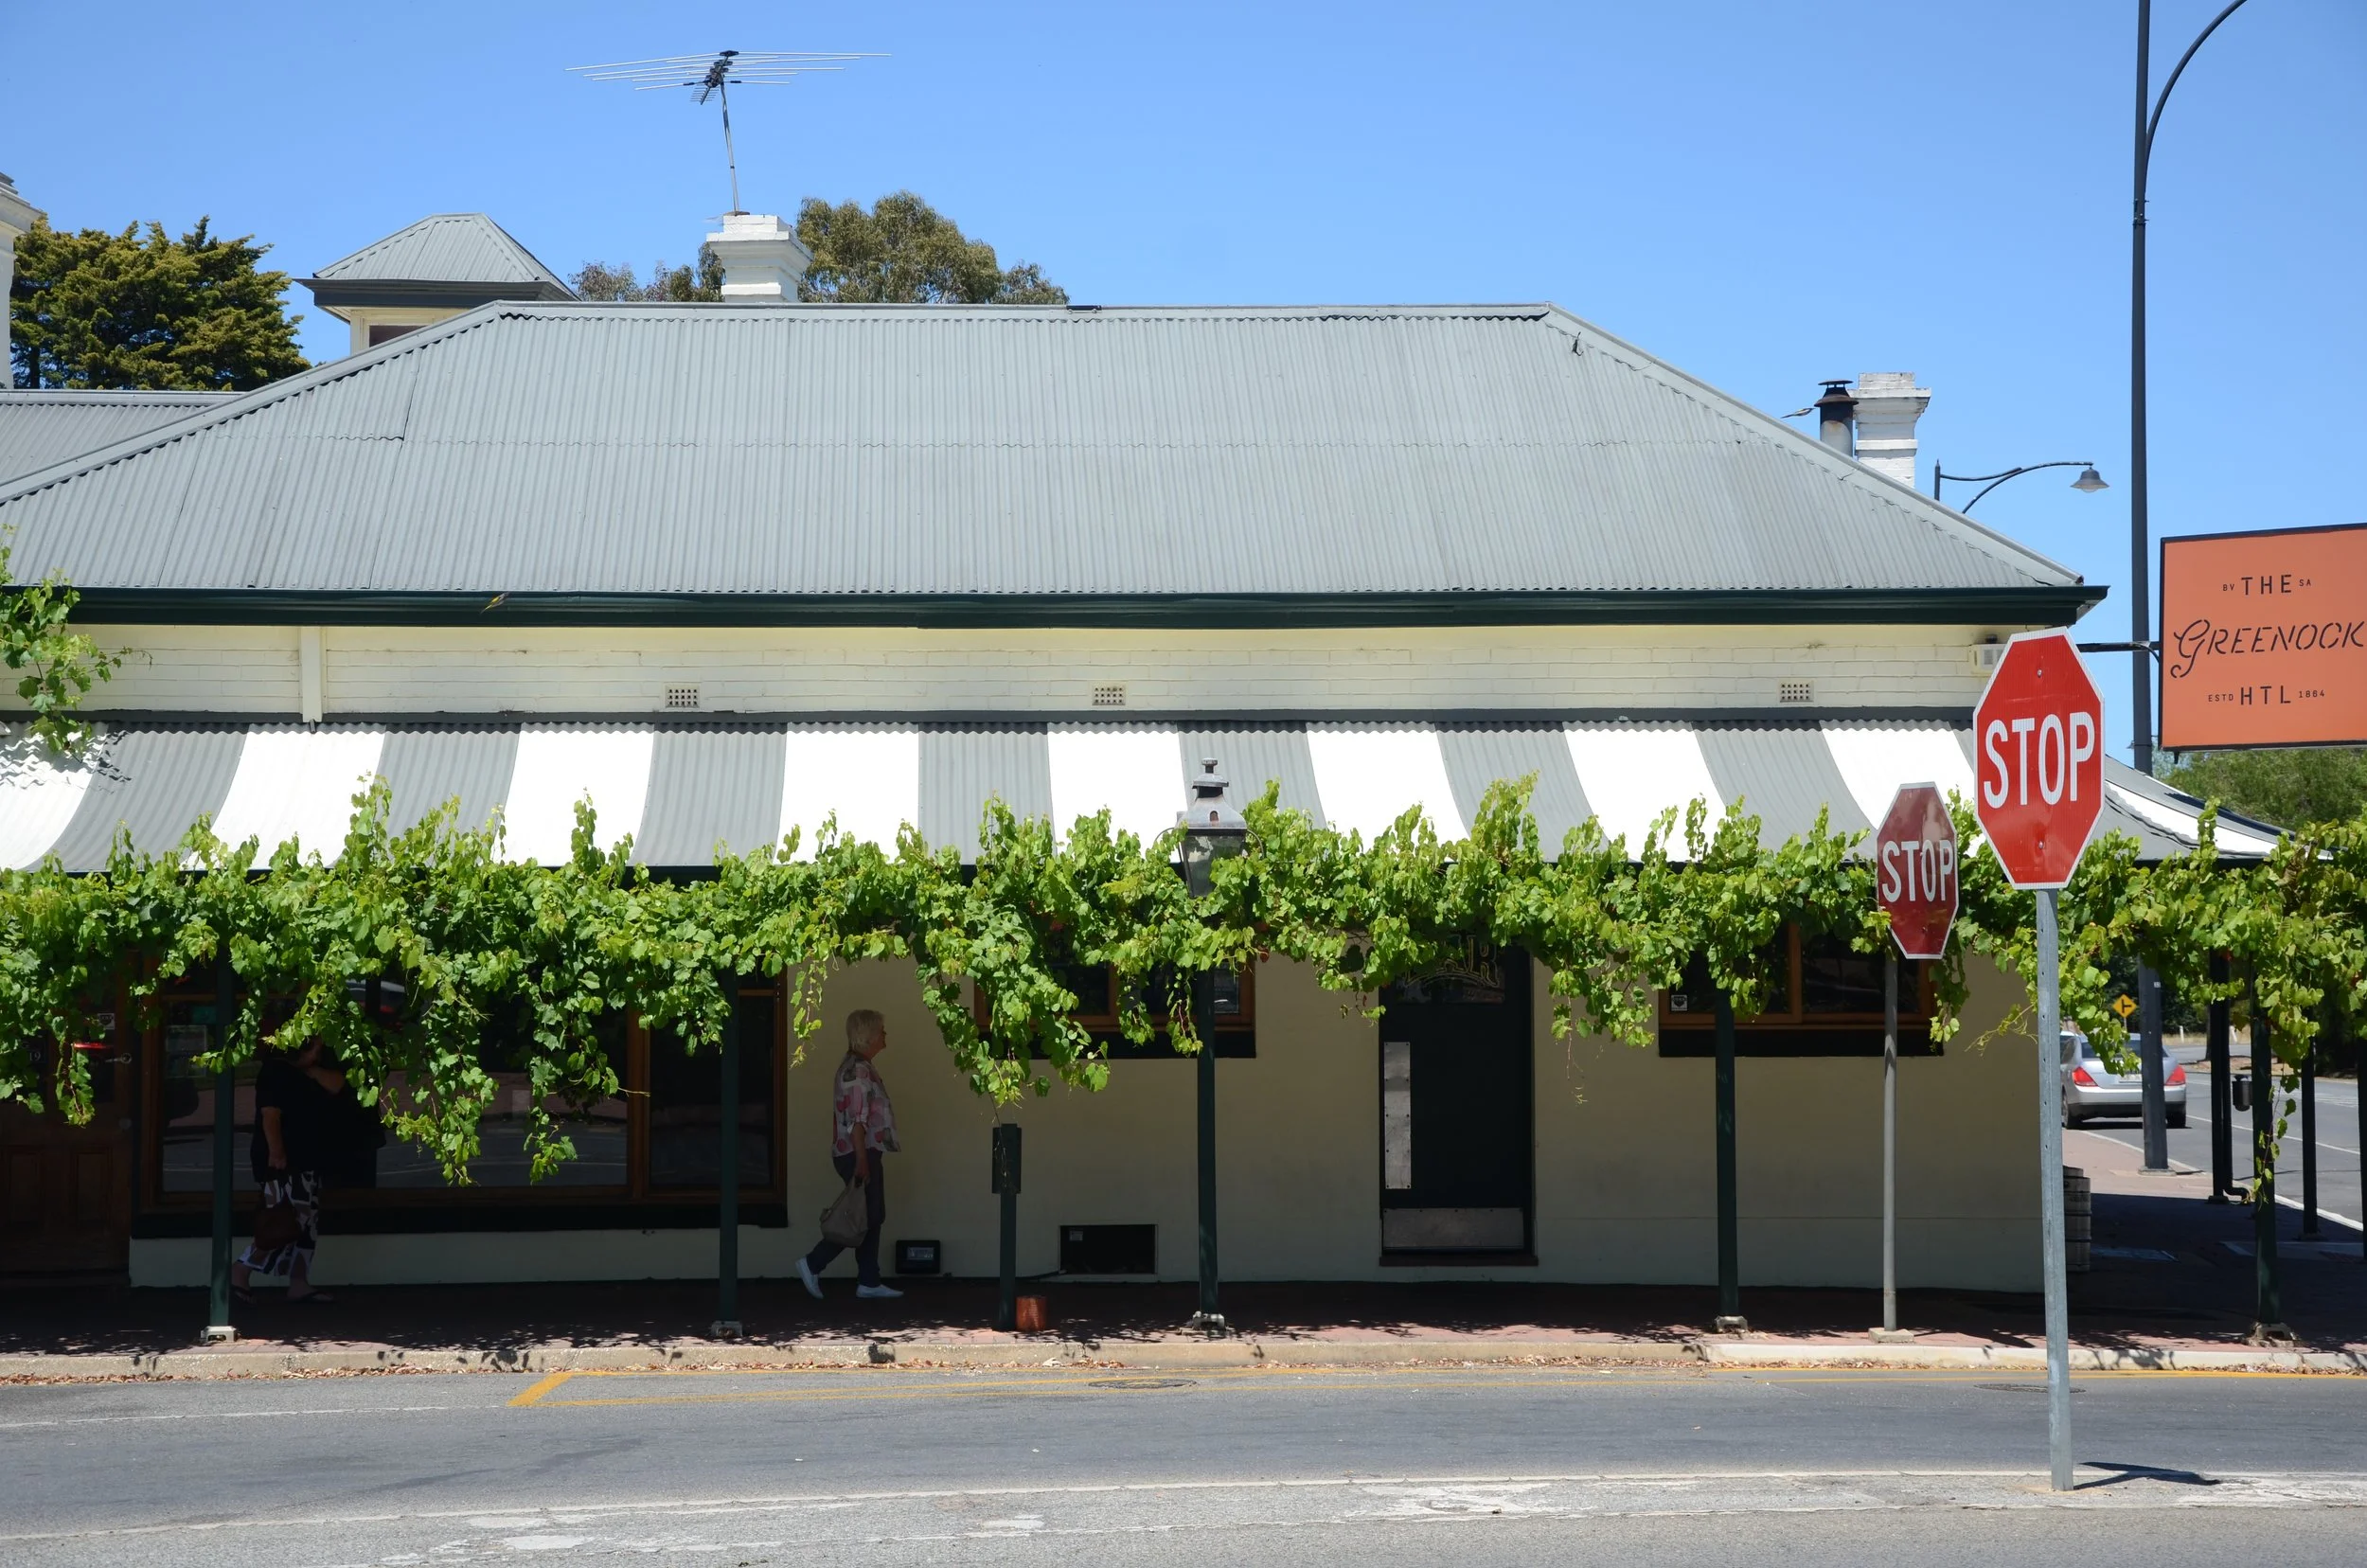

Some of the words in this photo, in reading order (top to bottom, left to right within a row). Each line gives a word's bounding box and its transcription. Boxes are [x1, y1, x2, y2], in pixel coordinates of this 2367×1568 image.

[2222, 583, 2235, 592] BV
[2241, 574, 2292, 596] THE
[2299, 579, 2312, 587] SA
[2170, 618, 2365, 678] GREENOCK
[2207, 693, 2234, 703] ESTD
[2240, 685, 2291, 705] HTL
[2298, 689, 2325, 699] 1864
[1984, 711, 2095, 810] STOP
[1881, 839, 1954, 902] STOP
